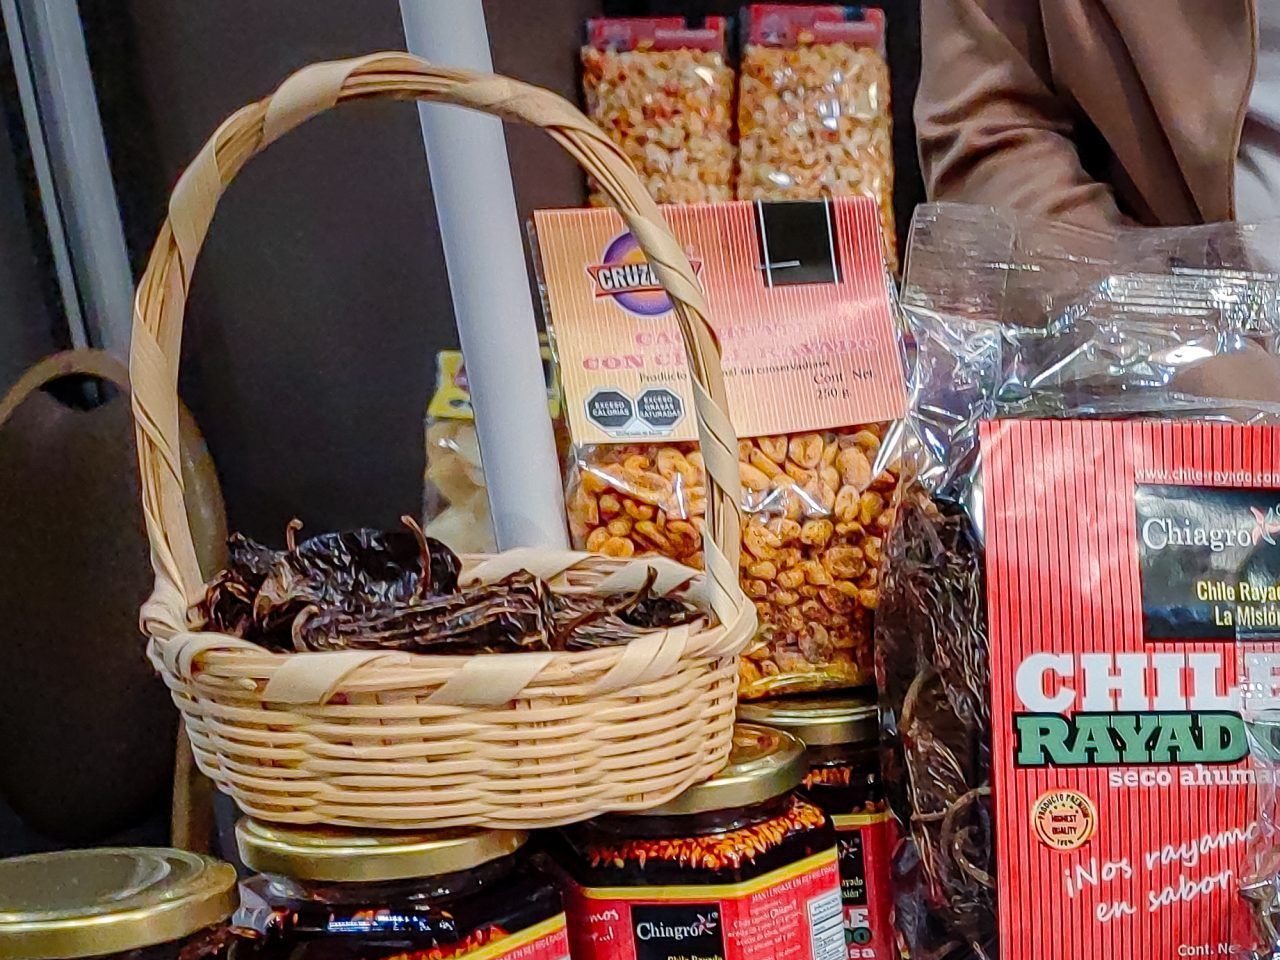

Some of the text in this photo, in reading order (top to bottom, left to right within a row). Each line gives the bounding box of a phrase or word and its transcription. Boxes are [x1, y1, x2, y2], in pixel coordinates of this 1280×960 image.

[1142, 517, 1251, 552] Chiagro
[1196, 581, 1236, 601] Chile
[1214, 605, 1233, 626] La
[1109, 767, 1172, 787] seco
[842, 878, 864, 891] ayado
[1095, 901, 1137, 923] en
[635, 921, 699, 941] Chiagro
